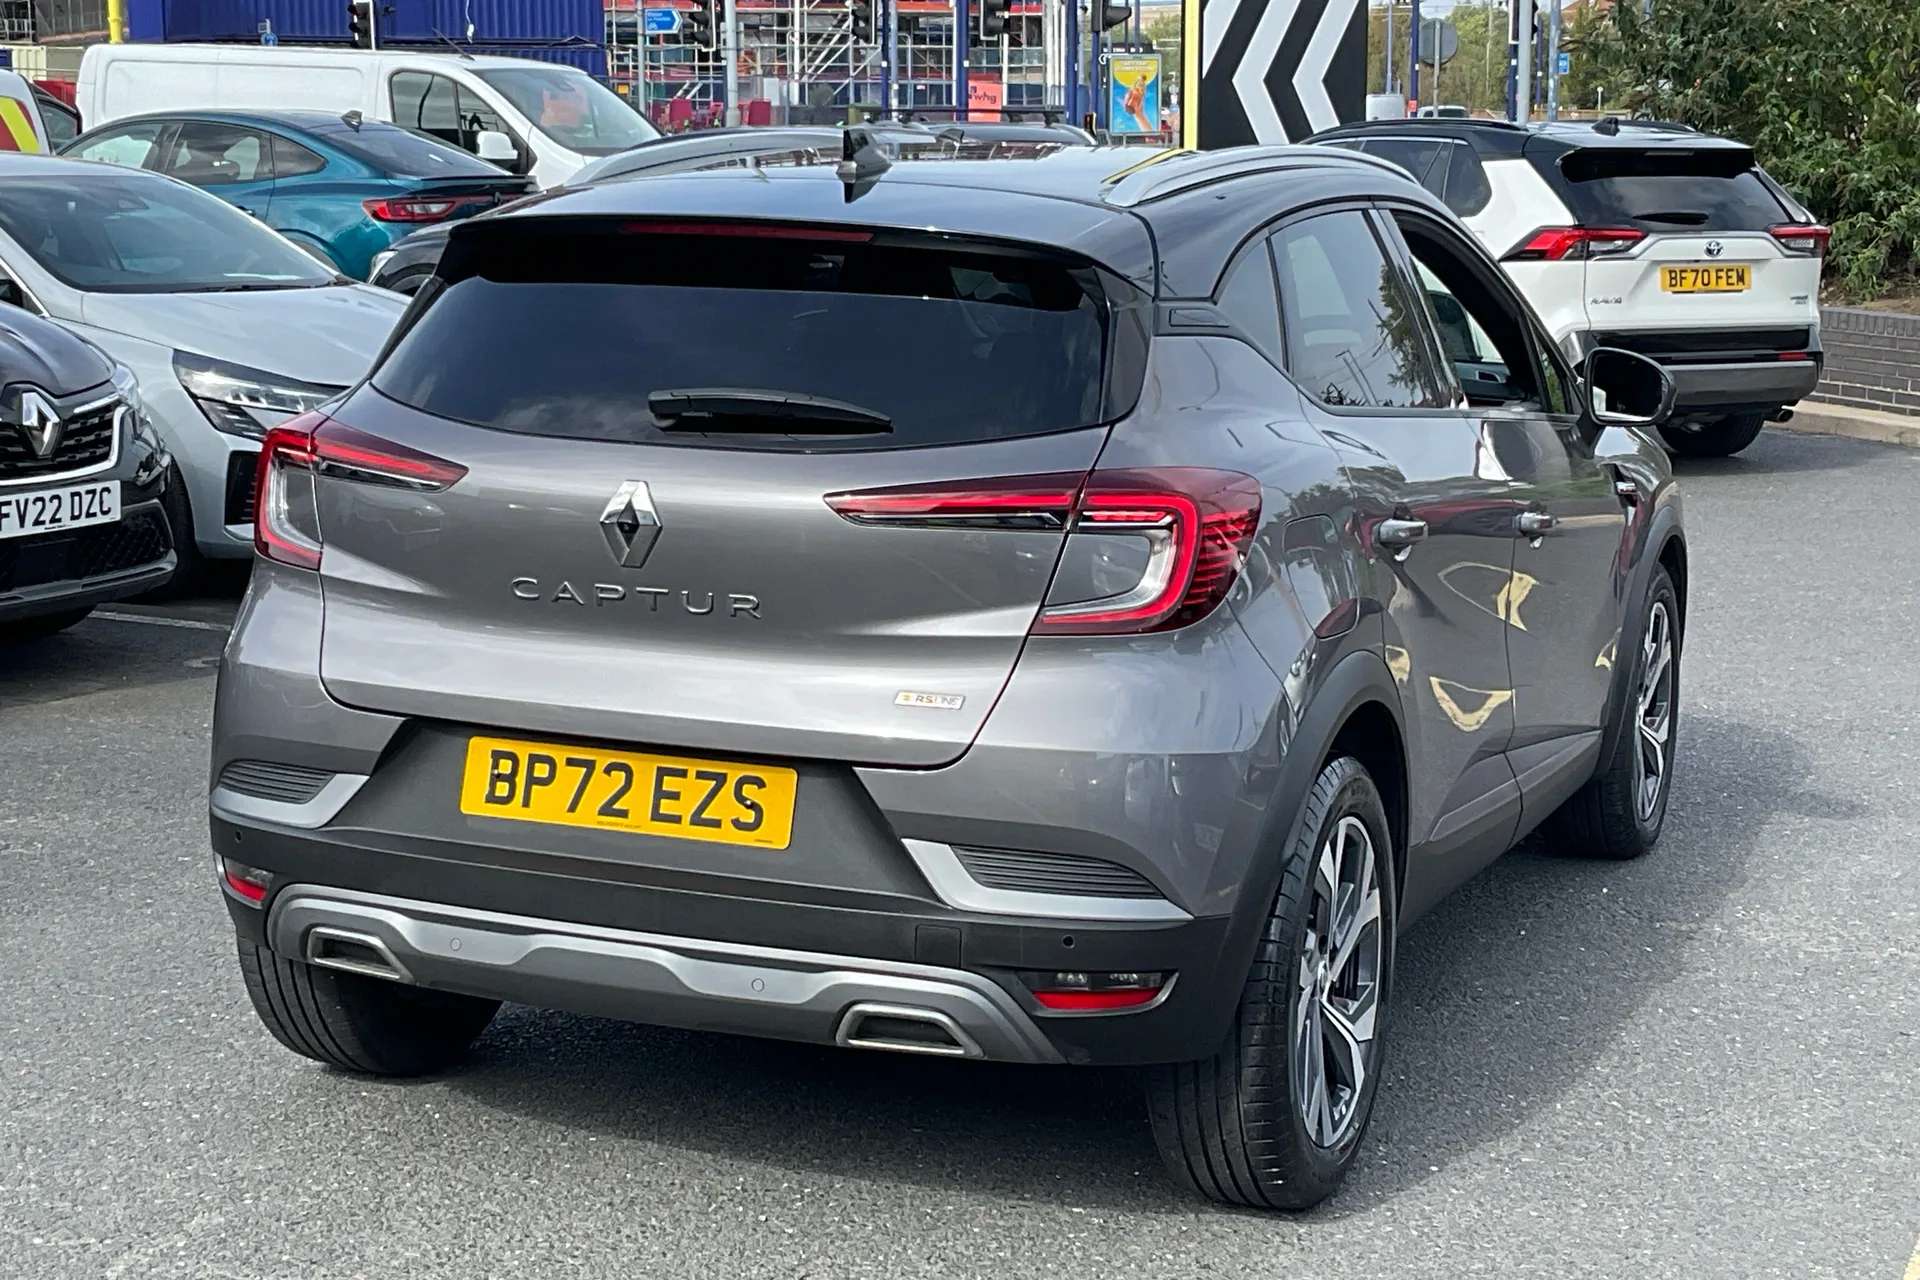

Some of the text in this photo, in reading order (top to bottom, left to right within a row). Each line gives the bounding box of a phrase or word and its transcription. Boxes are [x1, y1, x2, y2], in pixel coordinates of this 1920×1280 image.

[1668, 268, 1745, 287] BF70 FEM
[0, 487, 112, 531] FV22 DZC
[511, 577, 762, 619] CAPTUR
[483, 748, 767, 832] BP72 EZS
